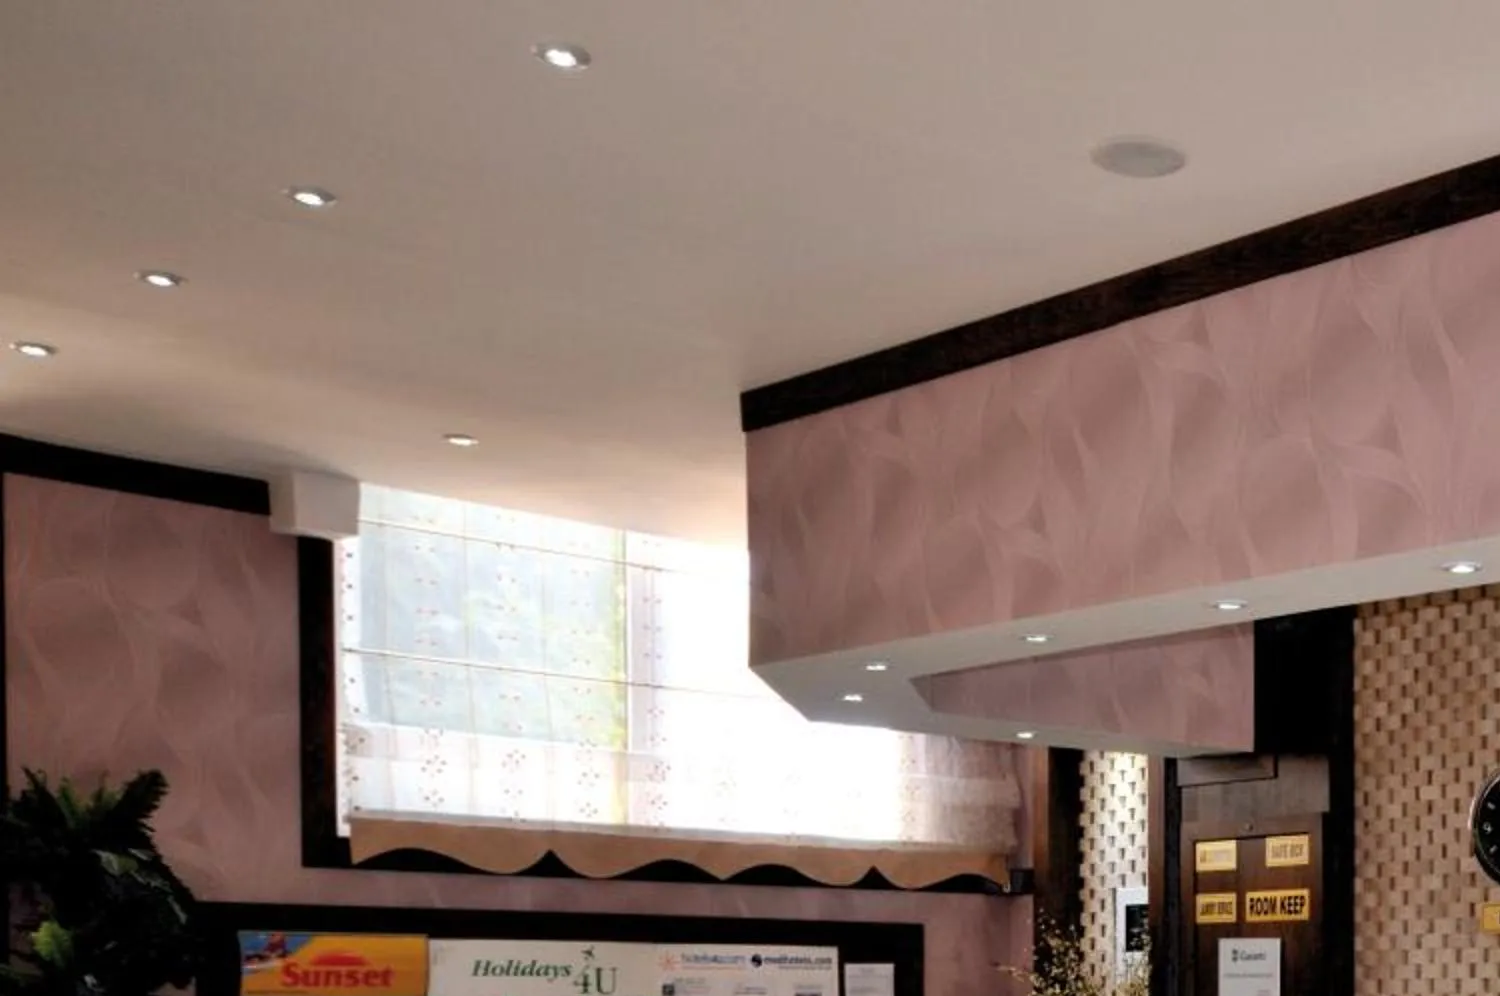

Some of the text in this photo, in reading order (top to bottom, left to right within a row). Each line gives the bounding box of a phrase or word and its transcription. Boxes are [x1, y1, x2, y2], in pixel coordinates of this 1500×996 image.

[1249, 897, 1278, 916] ROOM
[1280, 895, 1305, 915] KEEP
[281, 961, 393, 988] Sunset
[472, 959, 617, 995] Holidays 4U
